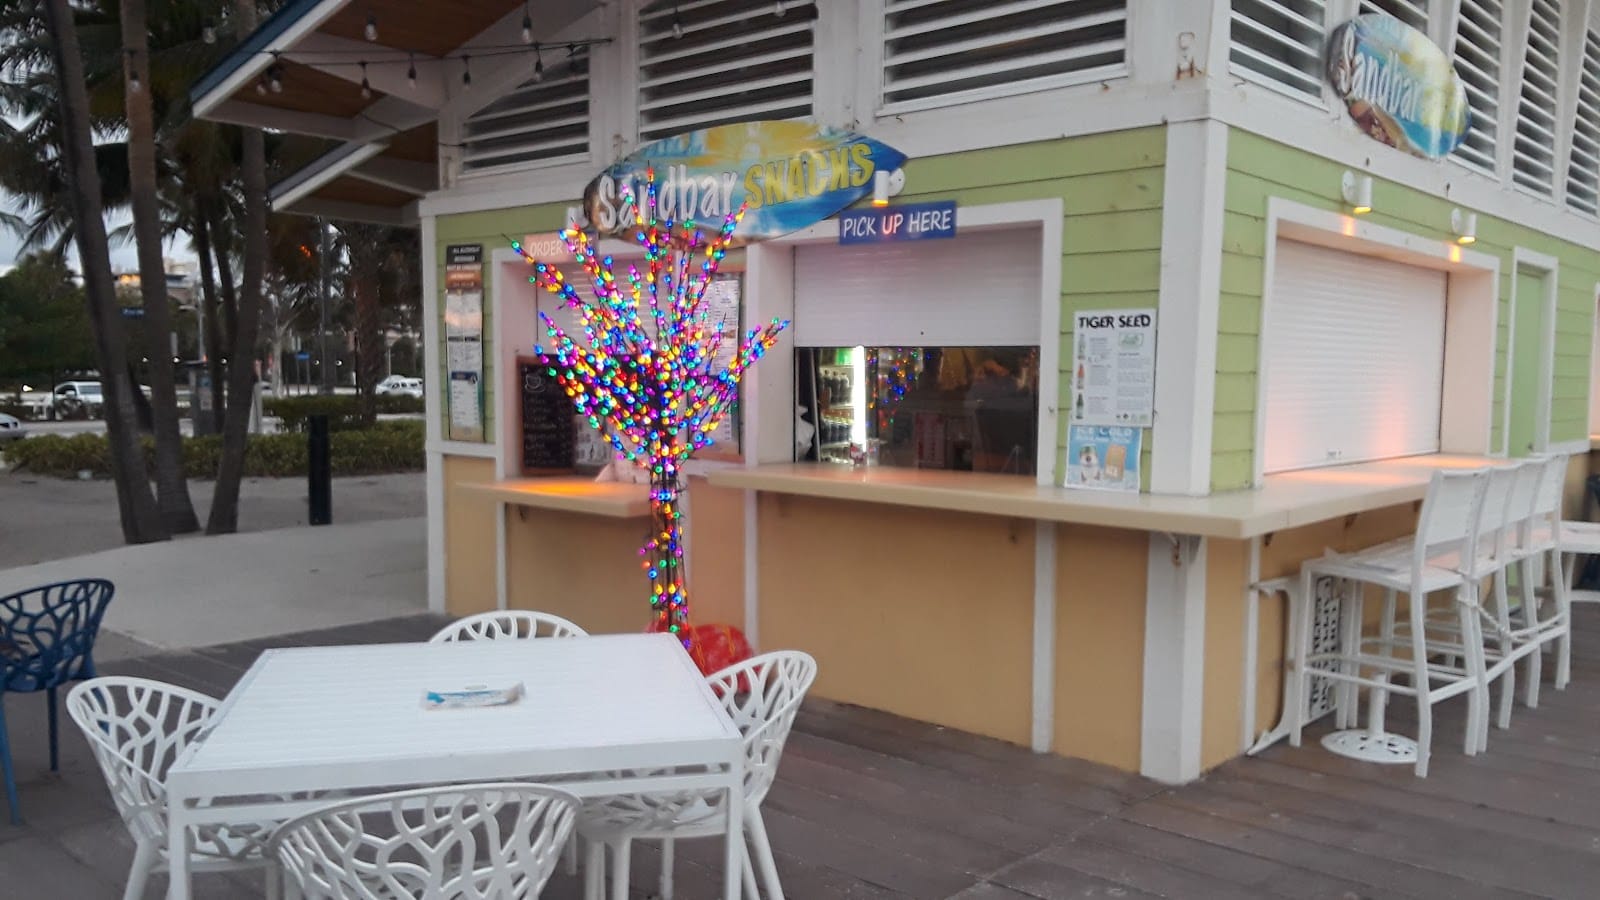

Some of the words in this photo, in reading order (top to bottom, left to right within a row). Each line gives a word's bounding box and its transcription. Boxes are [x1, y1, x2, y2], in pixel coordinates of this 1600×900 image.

[1338, 23, 1419, 122] Sandbar
[744, 143, 875, 209] SNACKS
[843, 216, 877, 238] PICK
[882, 213, 904, 235] UP
[908, 209, 953, 233] HERE
[530, 240, 563, 257] ORDER
[1078, 316, 1115, 329] TIGER
[1118, 314, 1151, 328] SEED
